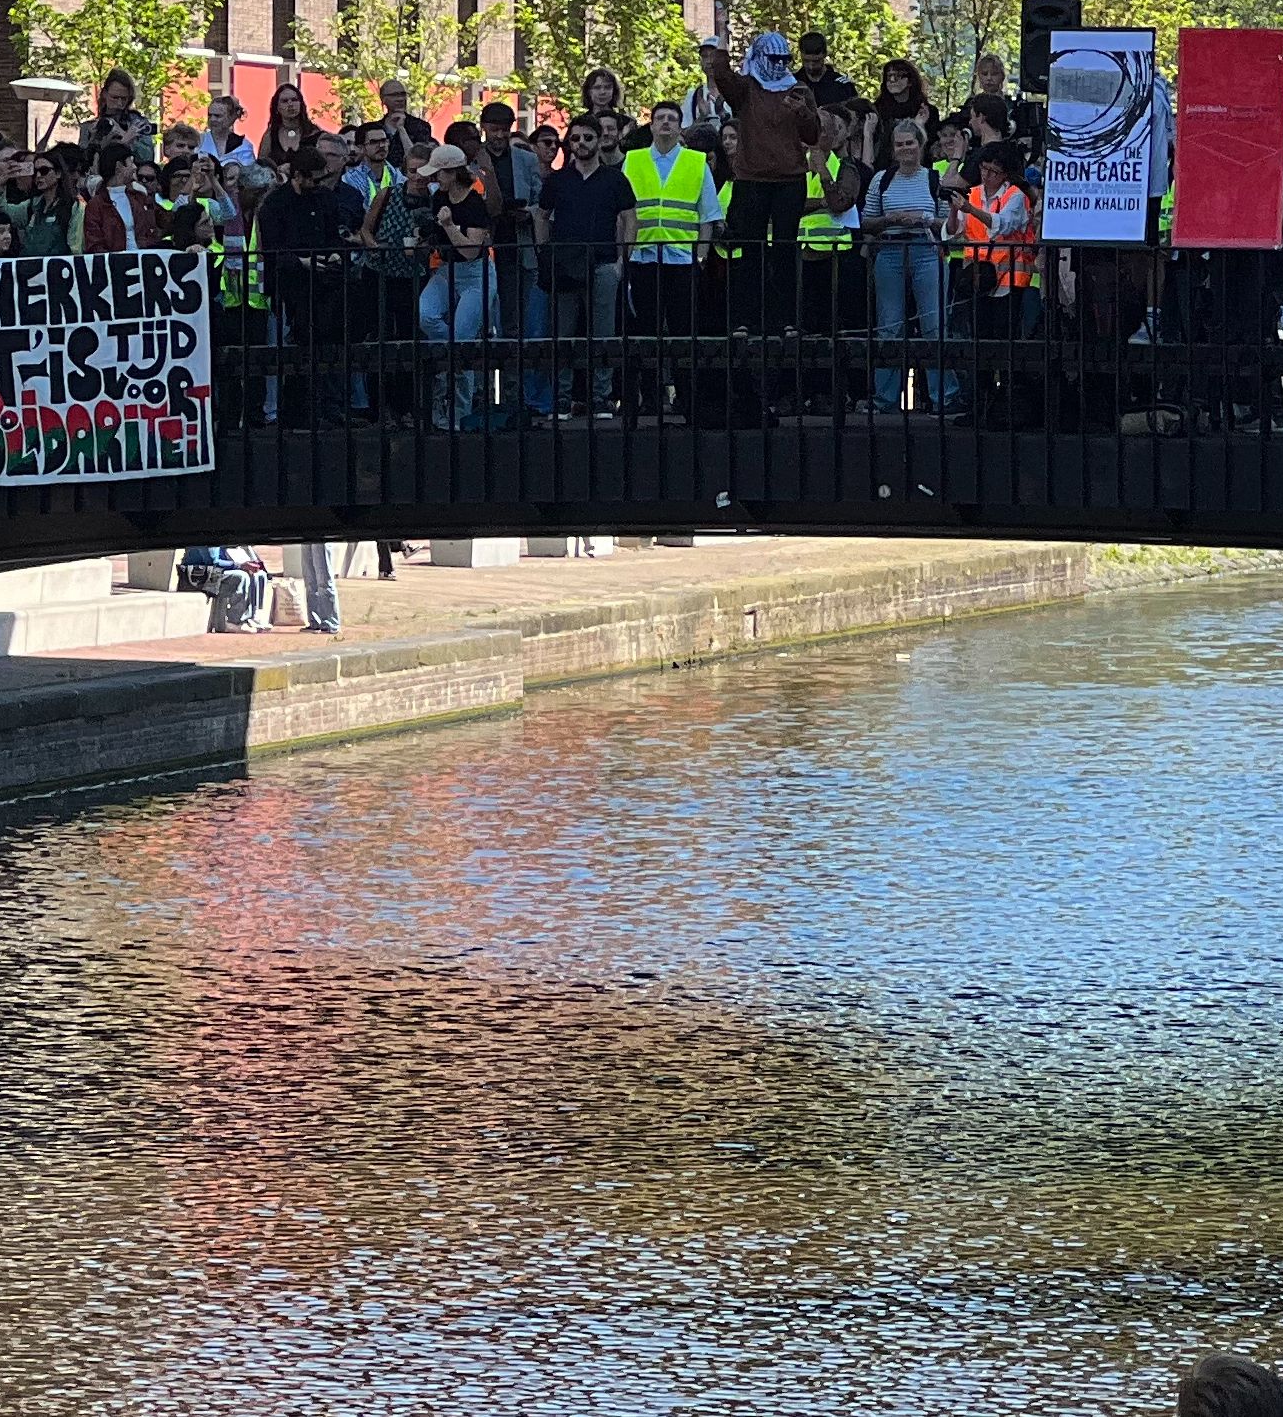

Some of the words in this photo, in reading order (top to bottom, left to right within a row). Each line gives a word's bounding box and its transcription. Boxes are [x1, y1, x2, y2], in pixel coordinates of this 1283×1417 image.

[1124, 146, 1143, 160] THE
[1048, 161, 1091, 182] IRON
[1097, 161, 1143, 182] CAGE
[1047, 197, 1090, 210] RASHID
[1094, 197, 1140, 211] KHALIDI
